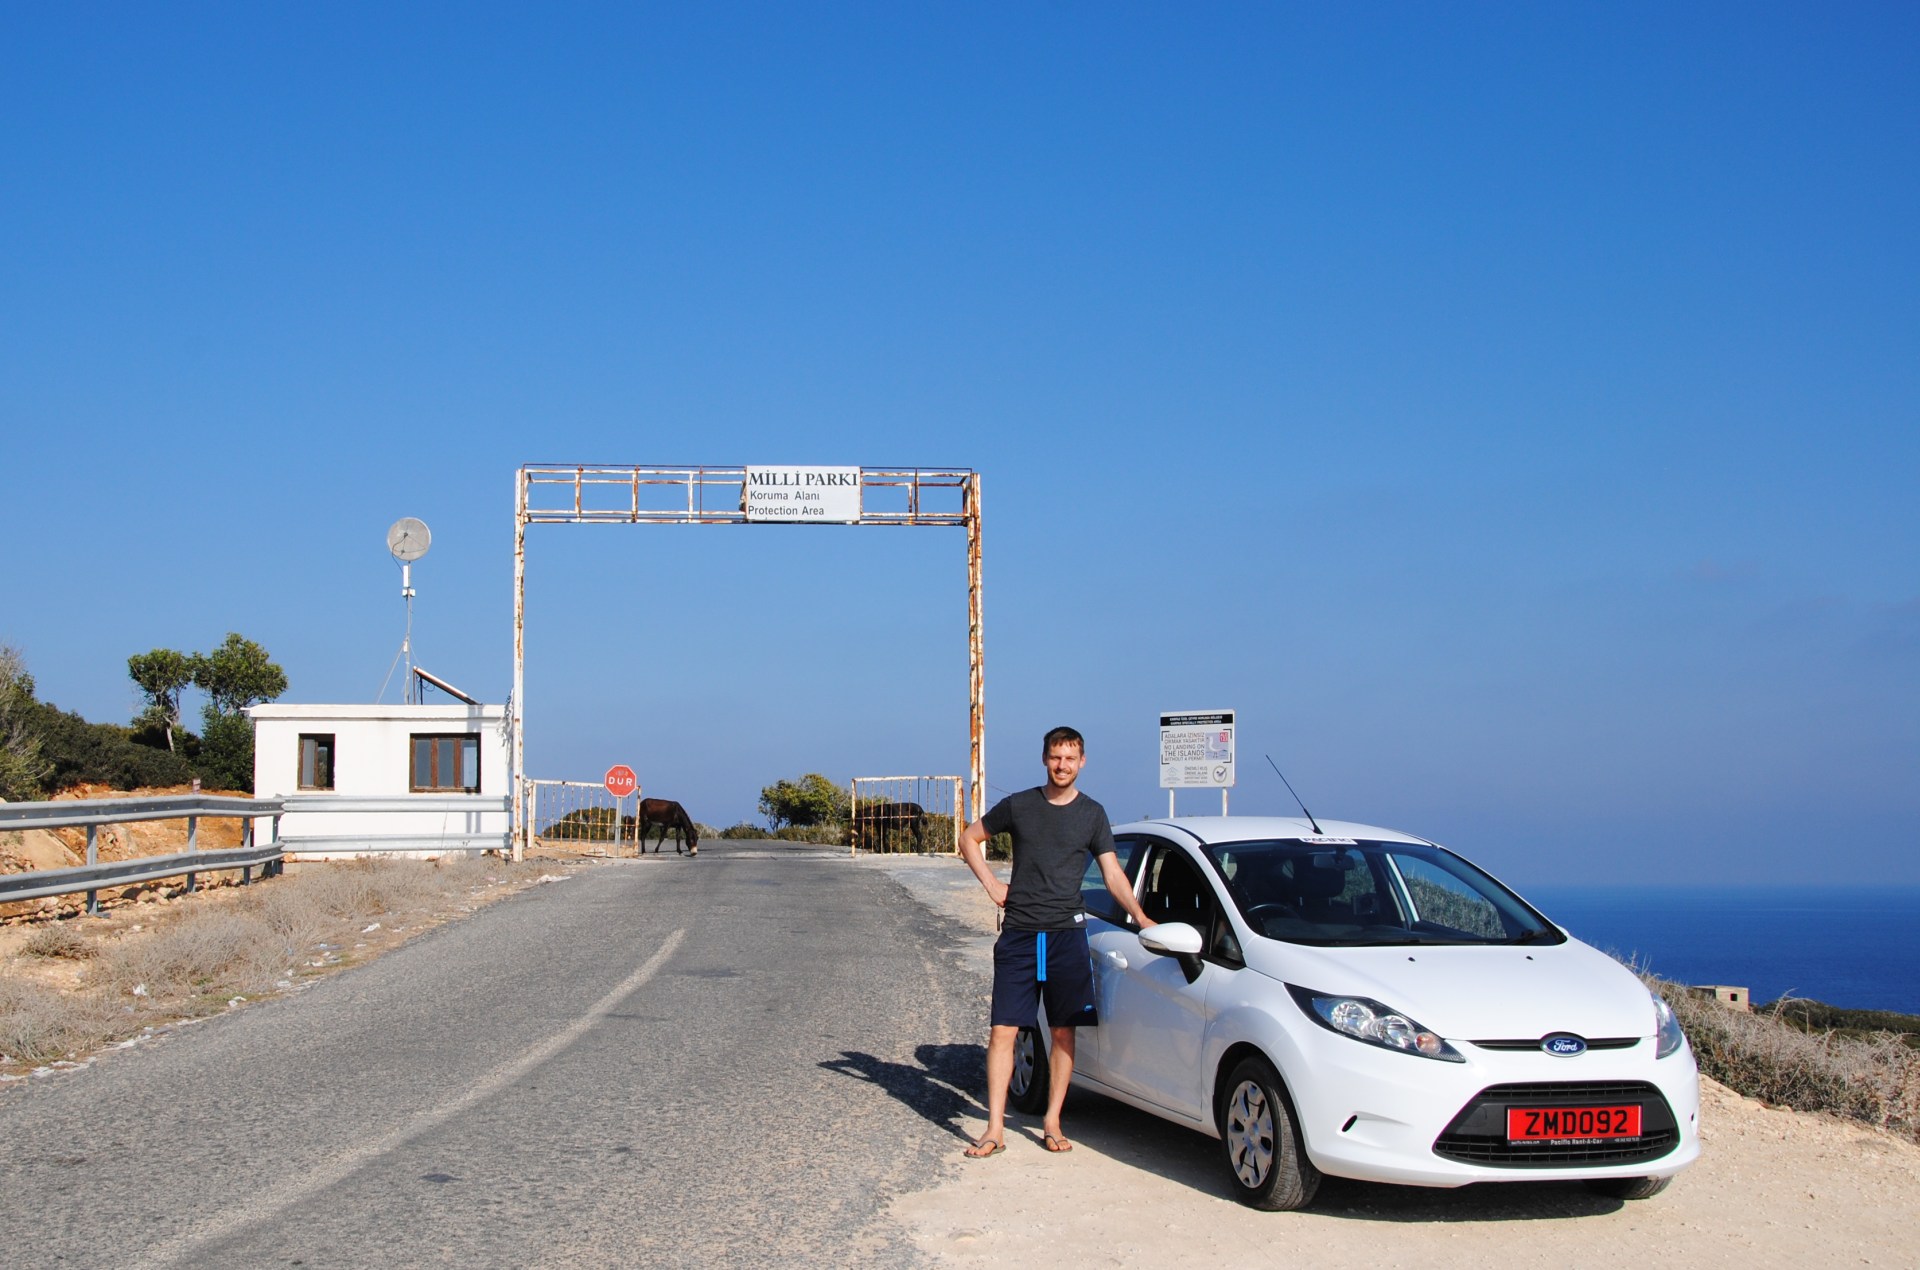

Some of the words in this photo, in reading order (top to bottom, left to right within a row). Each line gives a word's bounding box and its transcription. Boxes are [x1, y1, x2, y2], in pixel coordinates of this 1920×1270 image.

[748, 470, 801, 486] MİLLİ
[805, 472, 858, 486] PARKI
[750, 490, 789, 500] Koruma
[794, 490, 820, 501] Alanı
[748, 505, 798, 516] Protection
[801, 505, 825, 516] Area
[608, 776, 632, 786] DUR
[1553, 1040, 1578, 1051] Ford
[1525, 1109, 1628, 1136] ZMD092
